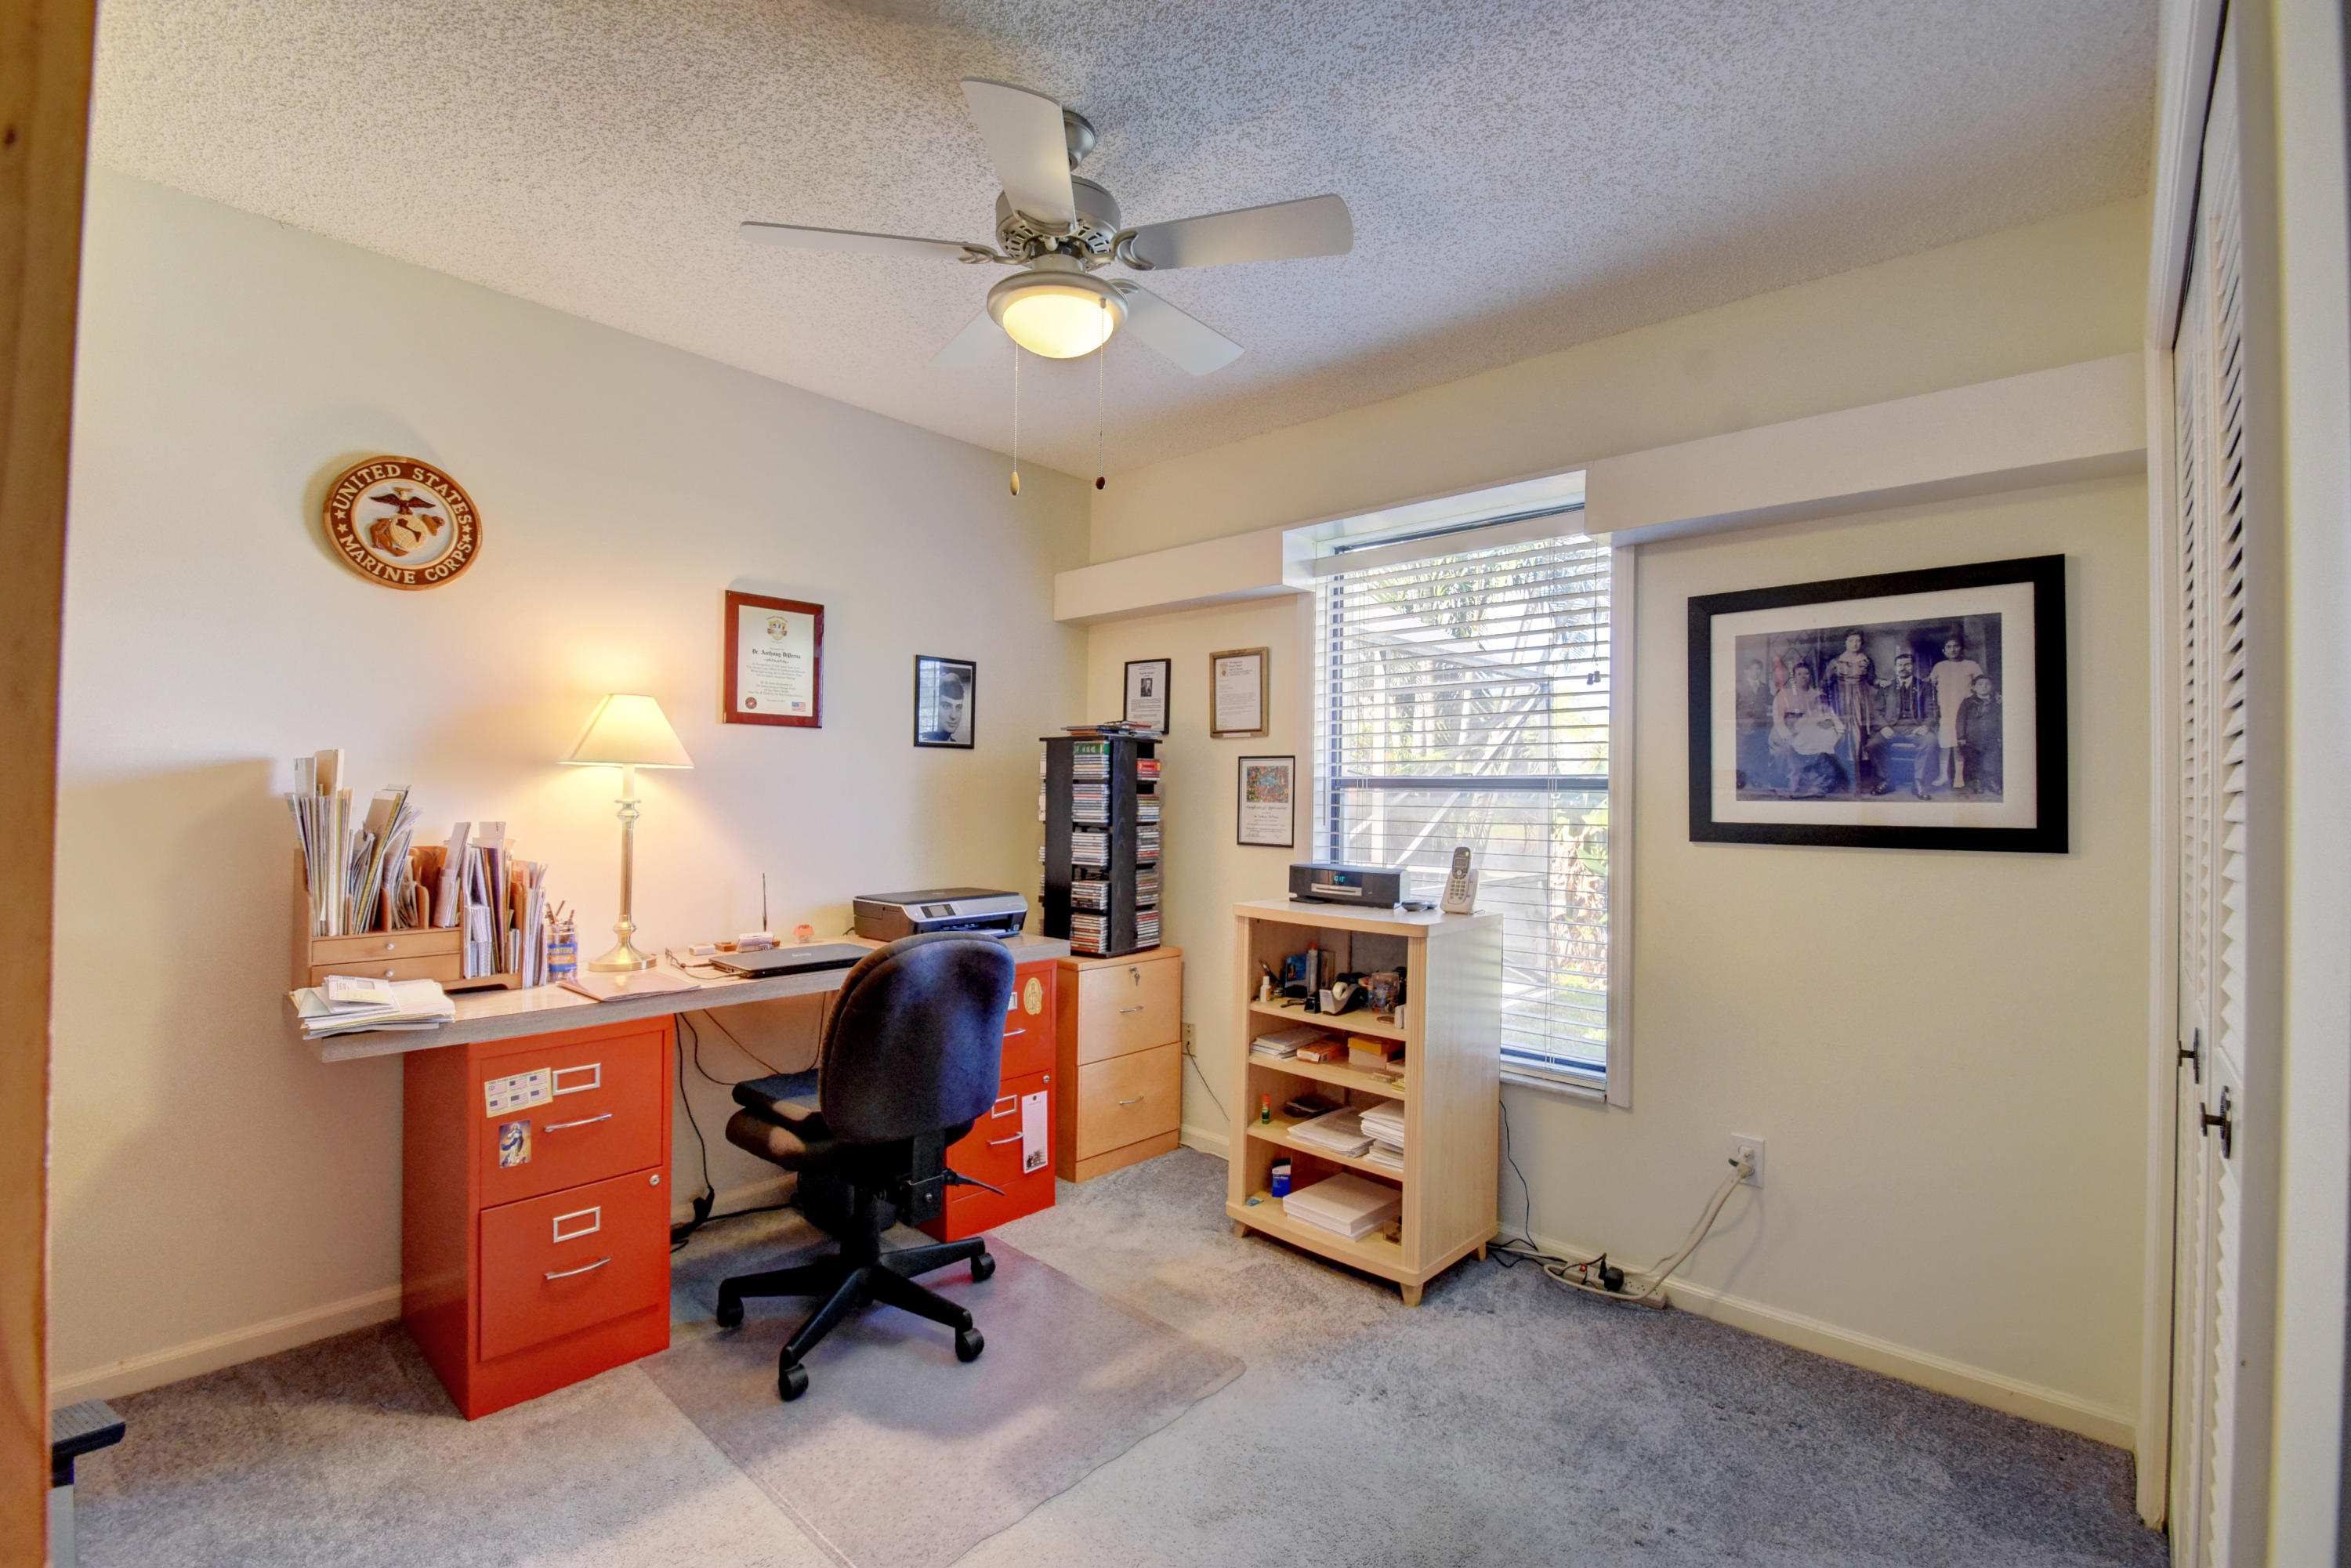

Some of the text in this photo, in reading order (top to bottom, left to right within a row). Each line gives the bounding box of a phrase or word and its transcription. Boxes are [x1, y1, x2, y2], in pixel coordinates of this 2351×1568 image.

[332, 464, 473, 524] UNITED STATES
[339, 534, 472, 584] MARINE CORPS
